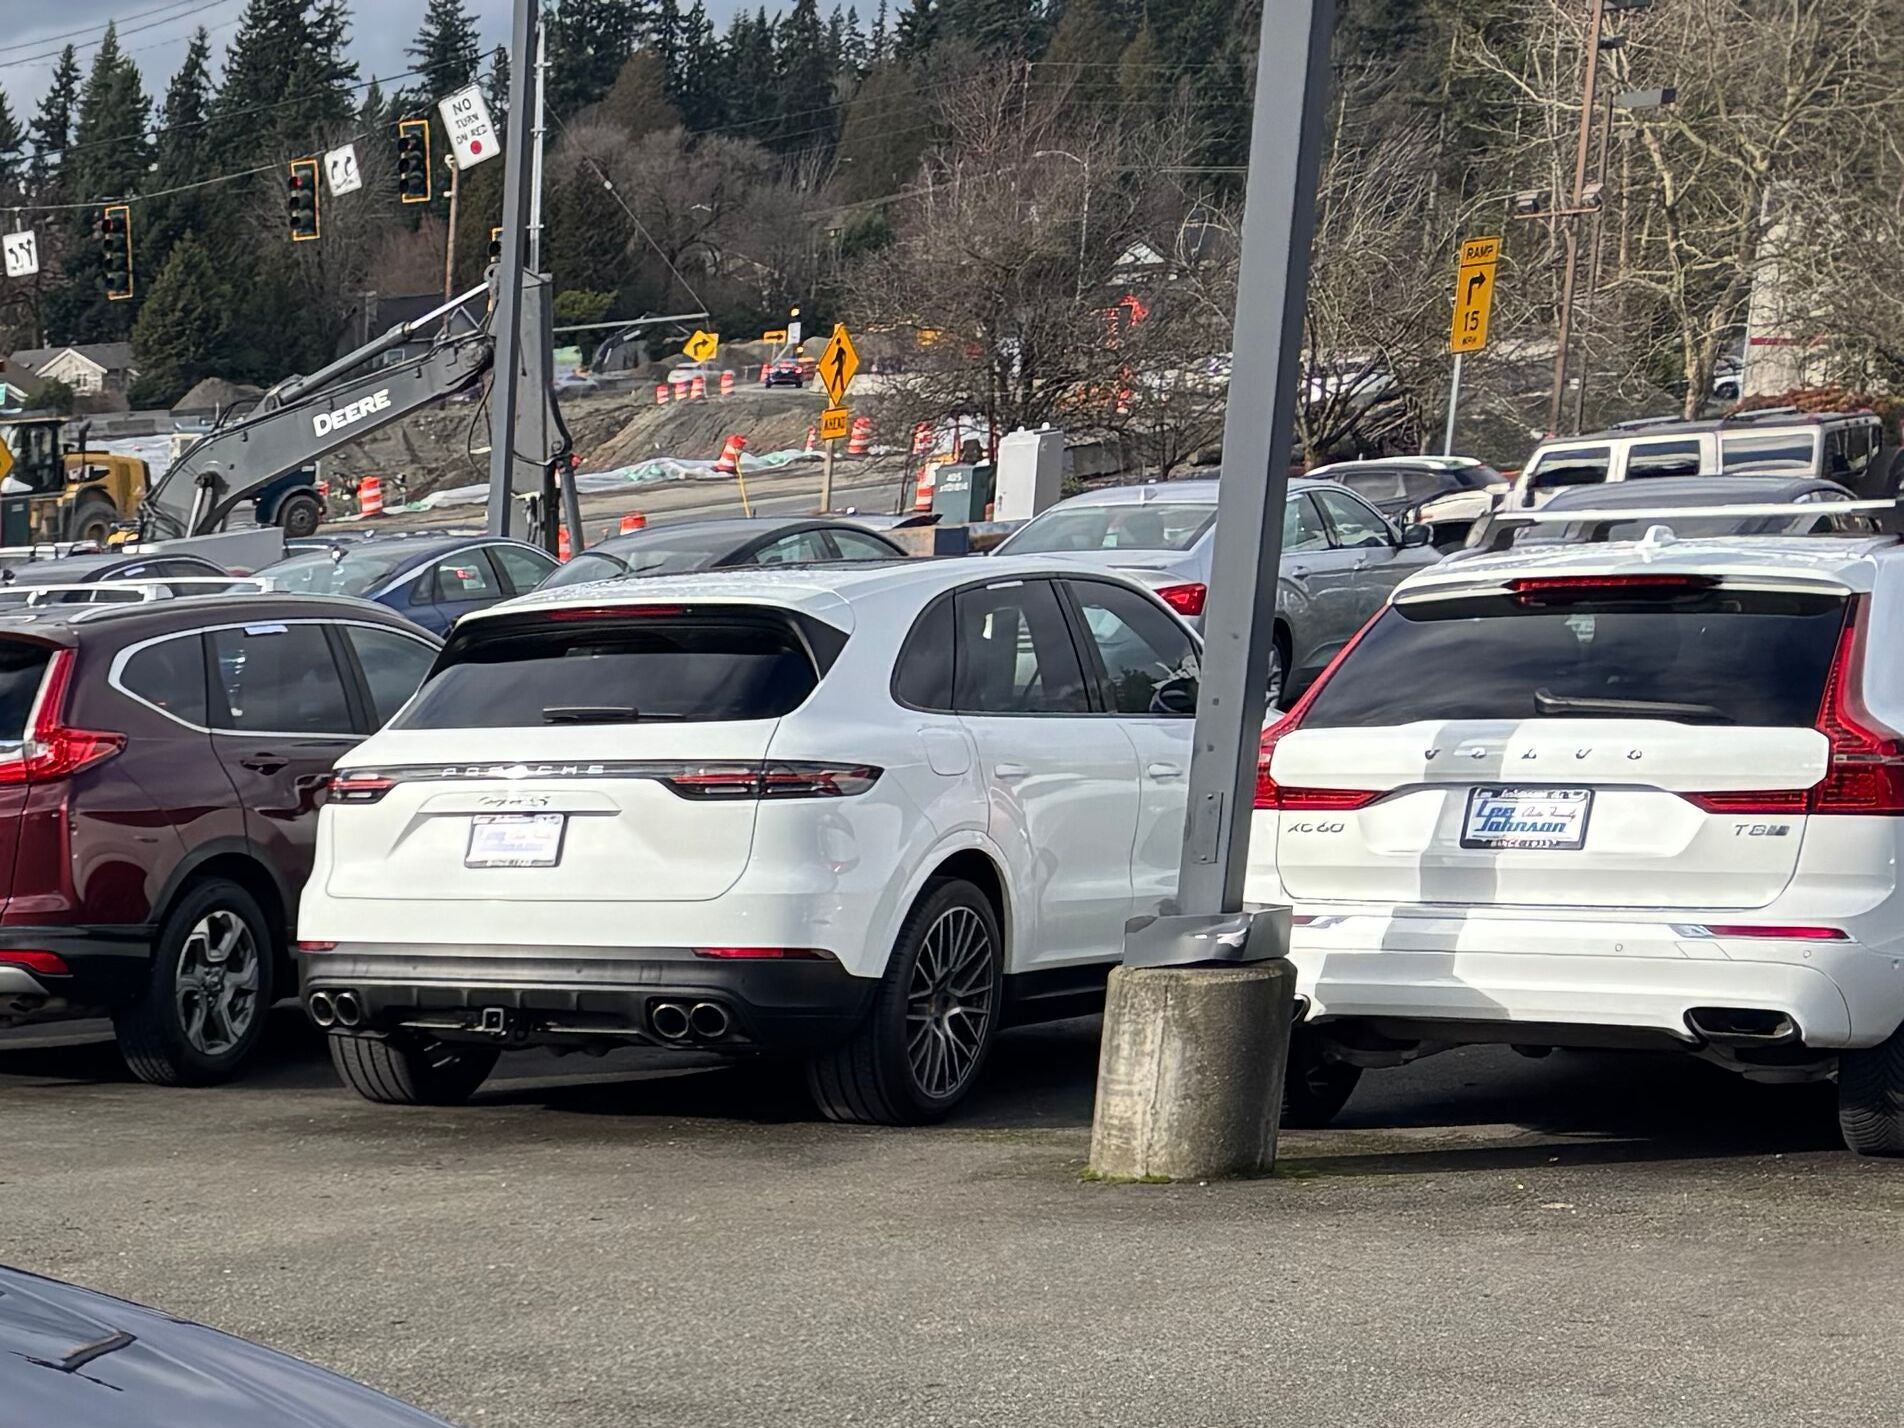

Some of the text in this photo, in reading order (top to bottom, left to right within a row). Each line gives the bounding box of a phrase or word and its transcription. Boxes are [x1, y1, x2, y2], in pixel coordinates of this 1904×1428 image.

[452, 98, 472, 116] NO
[455, 113, 480, 128] TURN
[456, 133, 468, 145] ON
[1466, 245, 1494, 260] RAMP
[1463, 310, 1480, 332] 15
[312, 389, 392, 438] DEERE
[441, 764, 605, 779] PORCHE
[1475, 799, 1516, 818] Lee
[1474, 817, 1568, 833] Johnson
